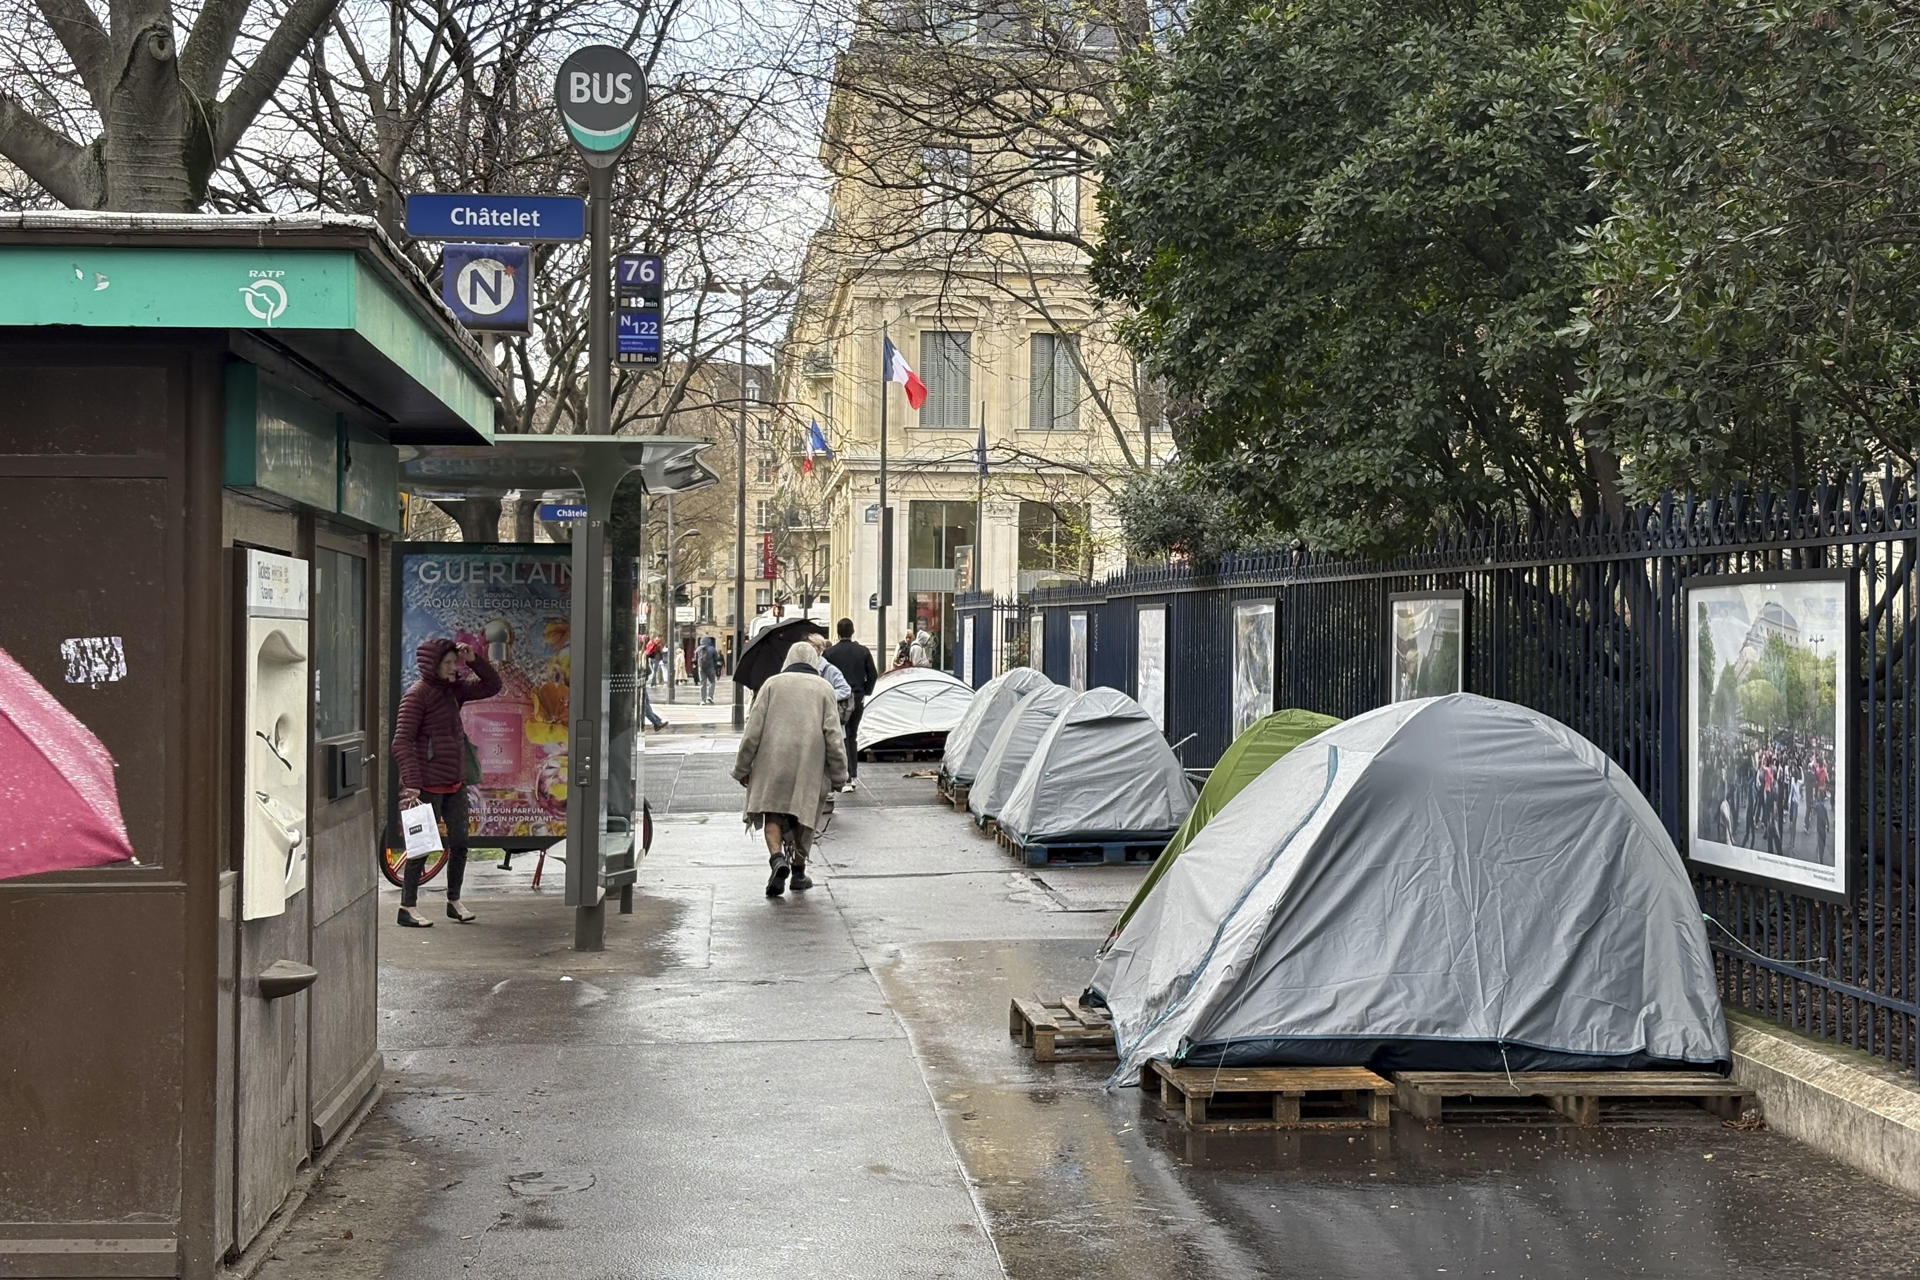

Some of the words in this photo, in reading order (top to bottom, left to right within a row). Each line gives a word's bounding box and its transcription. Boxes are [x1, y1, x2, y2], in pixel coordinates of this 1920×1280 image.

[570, 72, 633, 105] BUS
[450, 207, 541, 227] Châtelet
[248, 269, 286, 278] RATP
[623, 260, 656, 282] 76
[469, 268, 502, 307] N
[556, 508, 587, 518] Châtele
[418, 560, 572, 585] GUERLAIN
[424, 598, 460, 610] AQUA
[462, 598, 532, 609] ALLEGORIA
